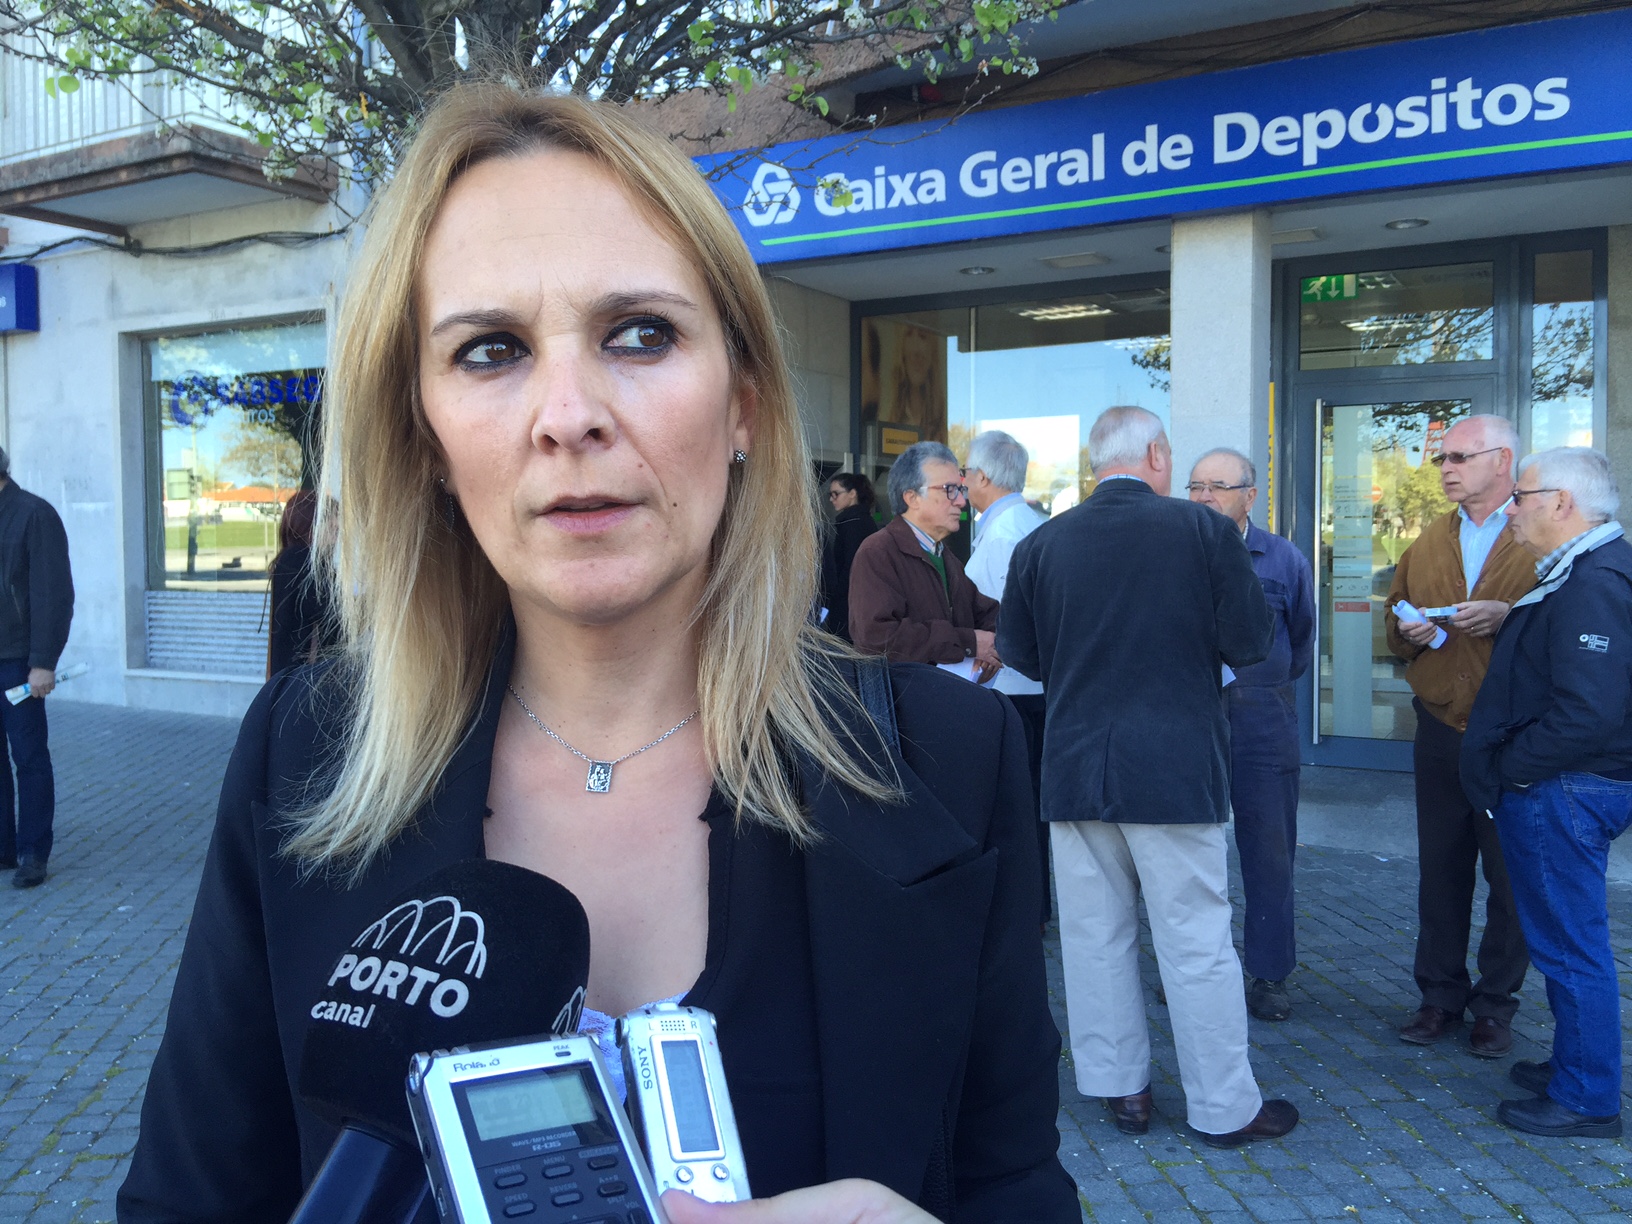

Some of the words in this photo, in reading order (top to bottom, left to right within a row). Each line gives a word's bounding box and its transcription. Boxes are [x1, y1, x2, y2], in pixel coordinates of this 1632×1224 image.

[813, 165, 946, 217] Caixa
[958, 132, 1106, 198] Geral
[1121, 123, 1194, 177] de
[327, 953, 470, 1018] PORTO
[310, 1000, 376, 1029] canal
[637, 1045, 653, 1090] SONY
[543, 1154, 566, 1165] MENU
[504, 1192, 529, 1204] SPEED
